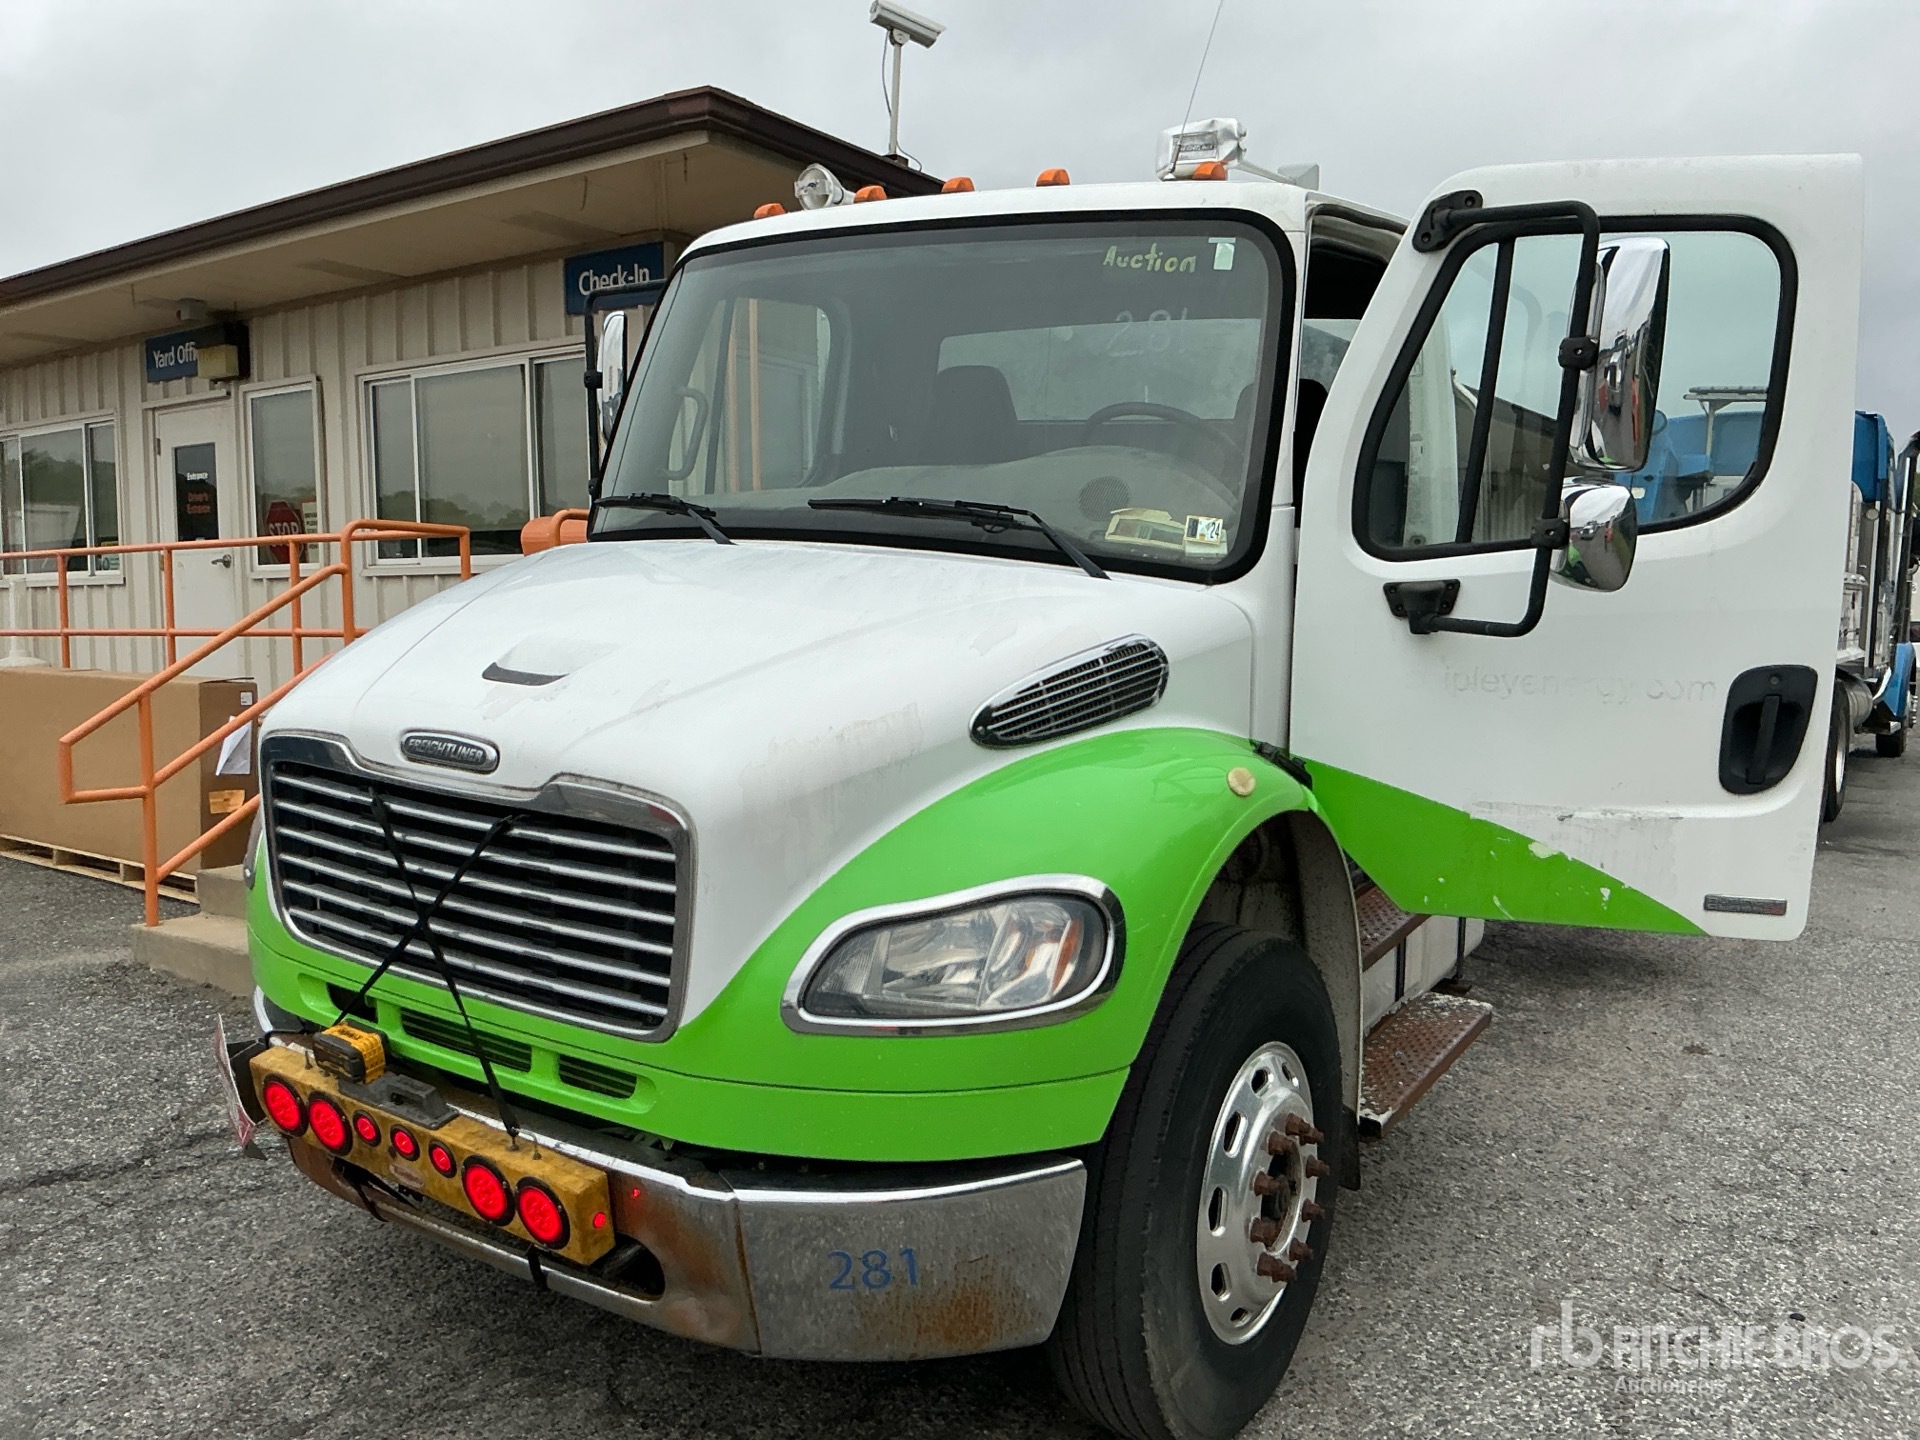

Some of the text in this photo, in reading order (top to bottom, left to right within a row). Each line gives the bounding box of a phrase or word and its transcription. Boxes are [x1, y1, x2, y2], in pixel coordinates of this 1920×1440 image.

[1102, 243, 1197, 273] Auction
[578, 263, 650, 296] Check-In
[153, 341, 198, 368] Yard Offi
[407, 738, 485, 762] FREIGHTLINER
[827, 1247, 918, 1290] 281
